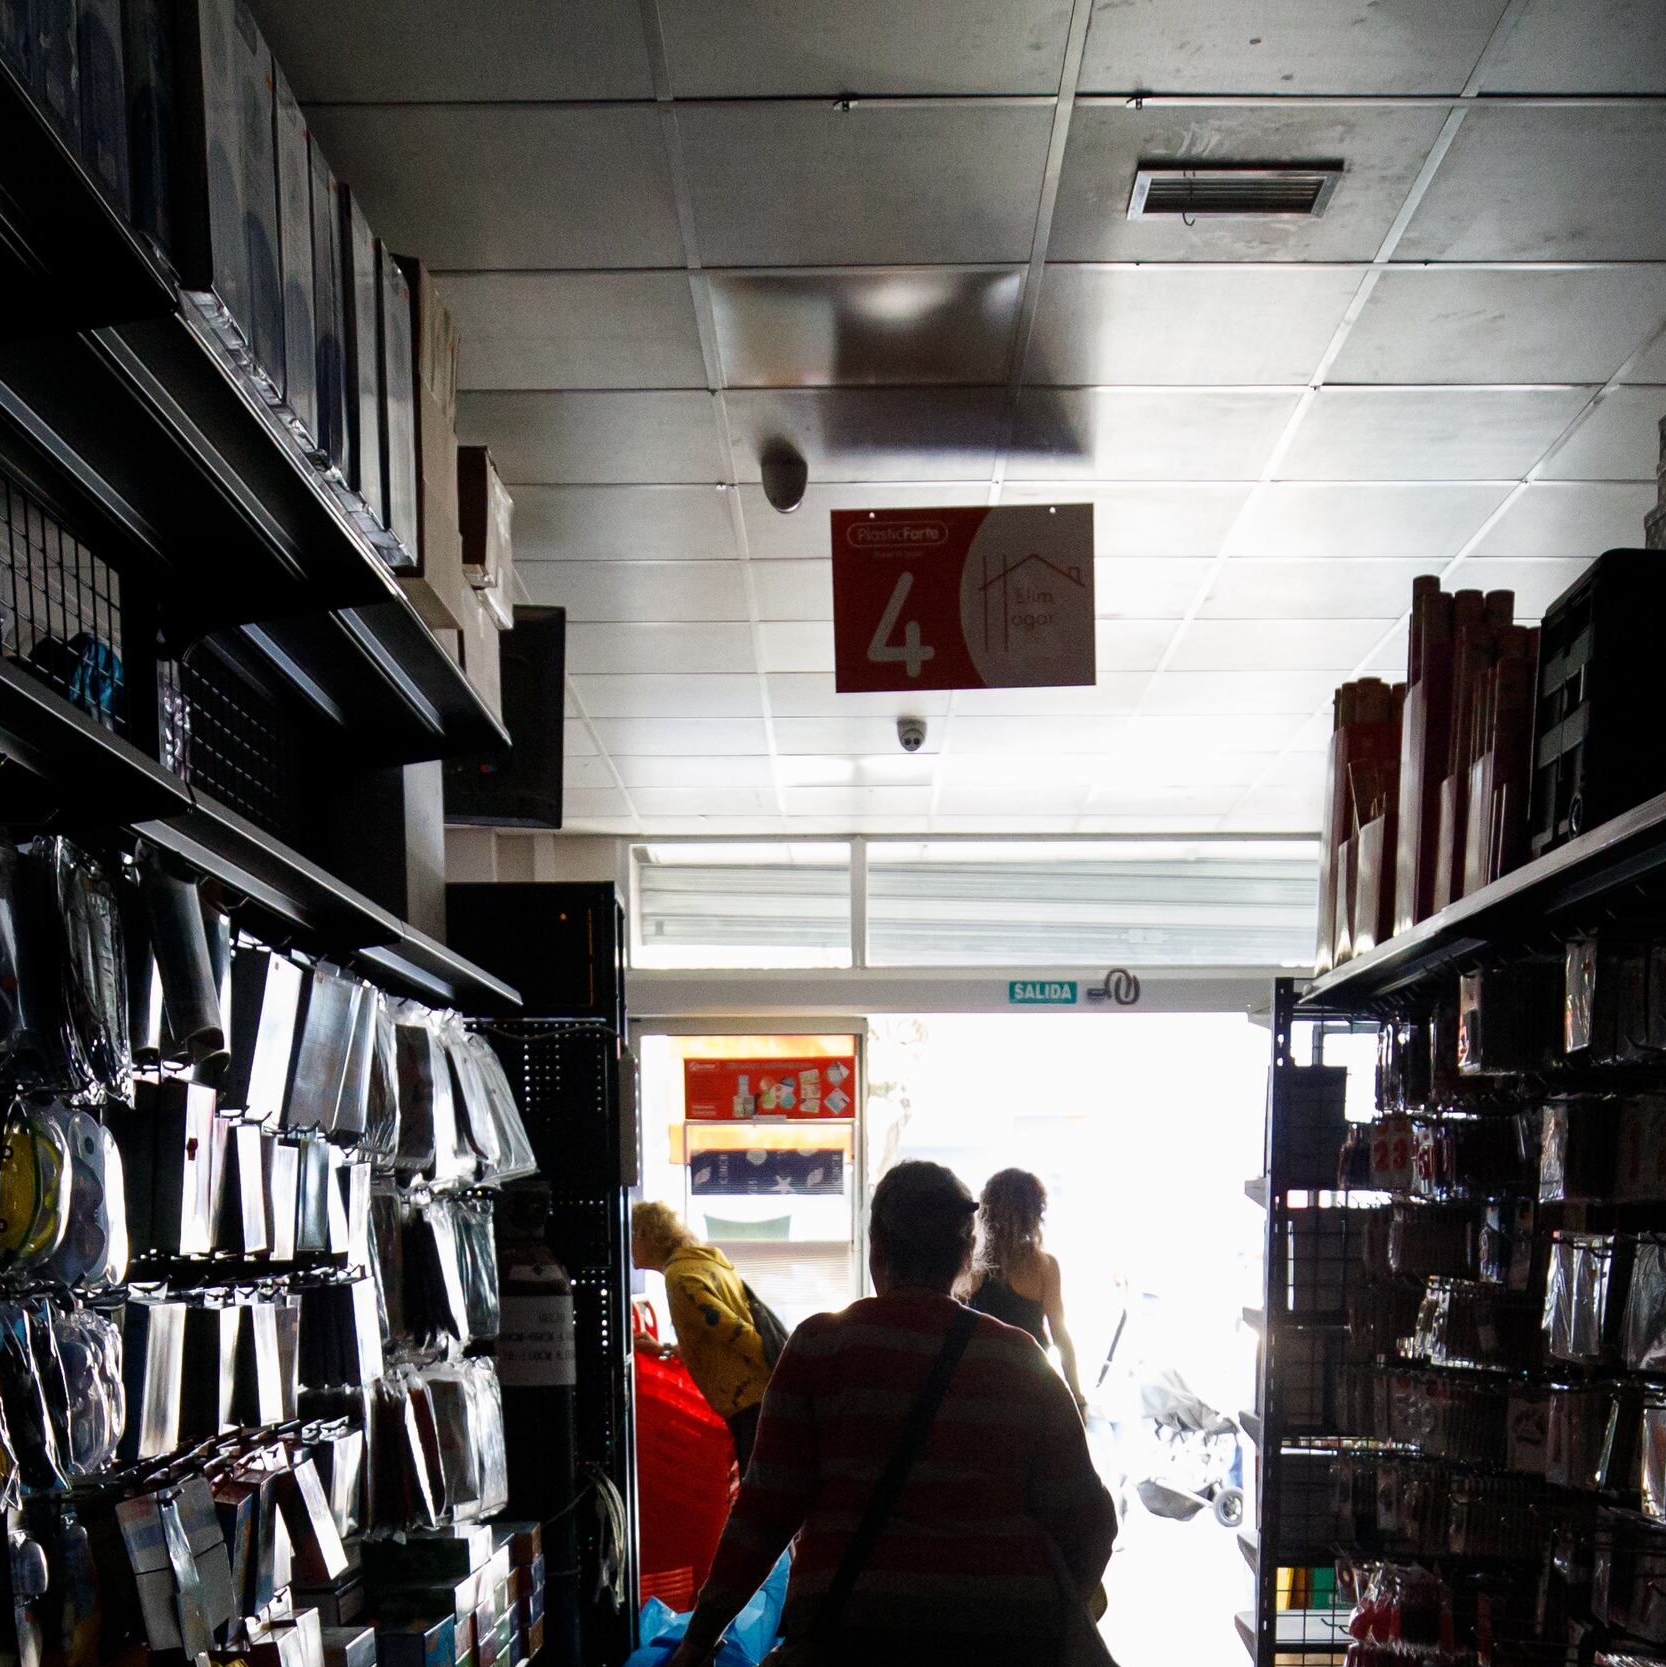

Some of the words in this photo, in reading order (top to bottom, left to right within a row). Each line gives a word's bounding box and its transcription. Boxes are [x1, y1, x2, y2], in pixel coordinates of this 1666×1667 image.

[857, 527, 940, 541] PlasticForte
[867, 571, 935, 678] 4
[1014, 983, 1072, 1000] SALIDA
